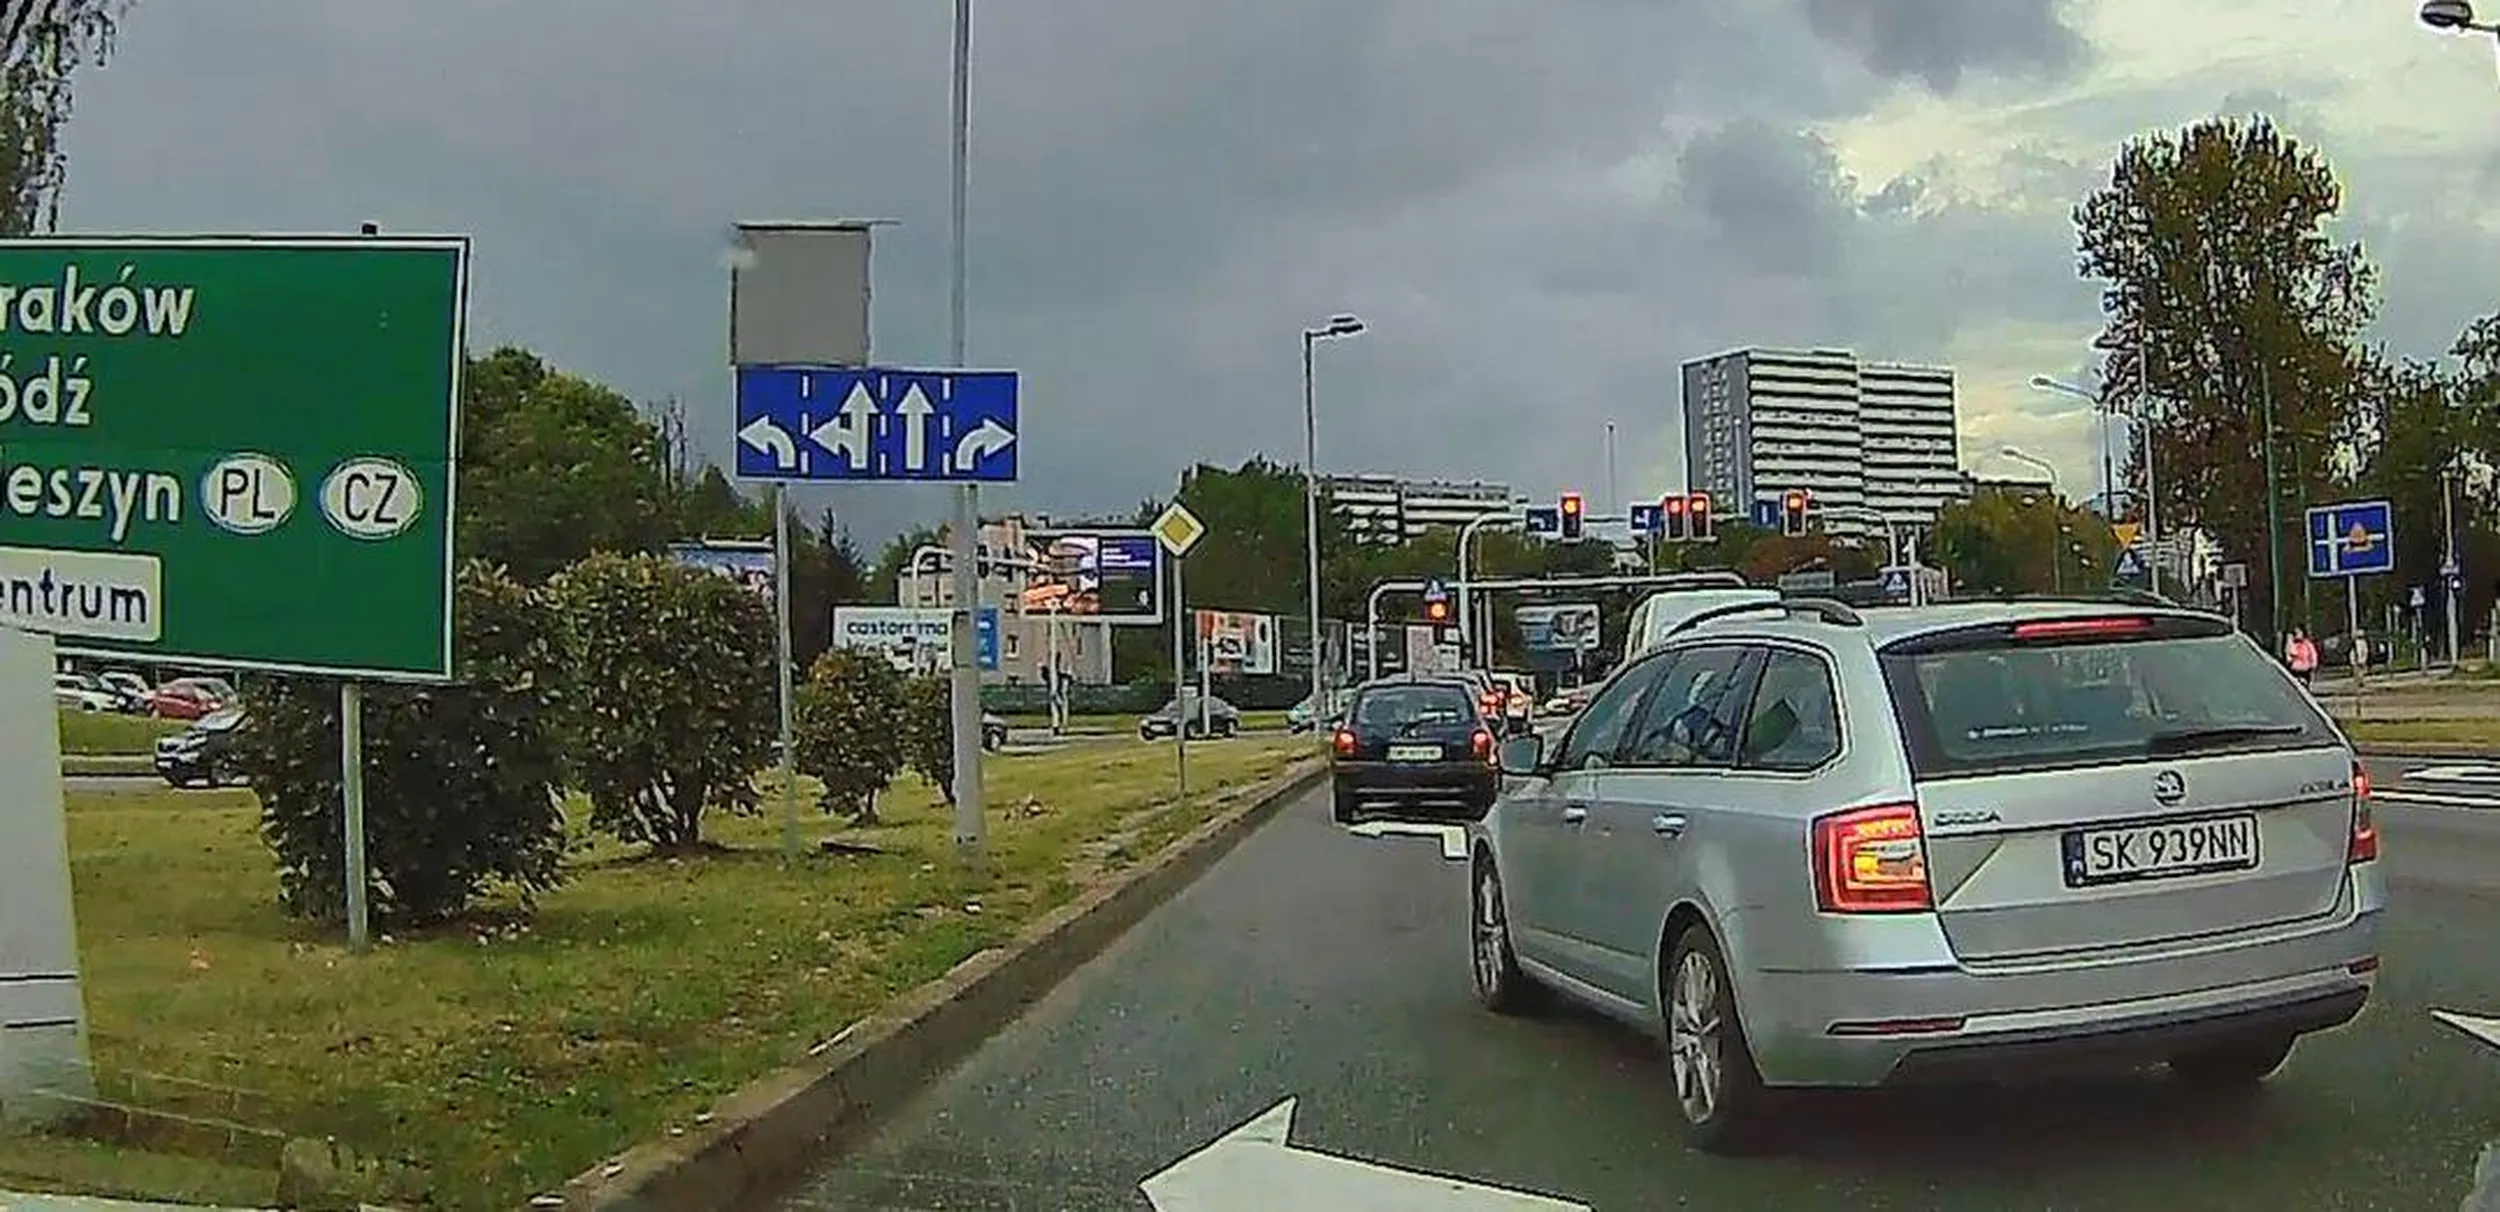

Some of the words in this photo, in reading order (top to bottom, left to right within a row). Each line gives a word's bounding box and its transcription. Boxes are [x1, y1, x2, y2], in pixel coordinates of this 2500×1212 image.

[0, 265, 194, 335] raków
[0, 466, 180, 541] eszyn
[220, 468, 275, 519] PL
[345, 473, 399, 523] CZ
[0, 568, 147, 623] ntrum
[2093, 833, 2136, 870] SK
[2150, 821, 2248, 866] 939NN
